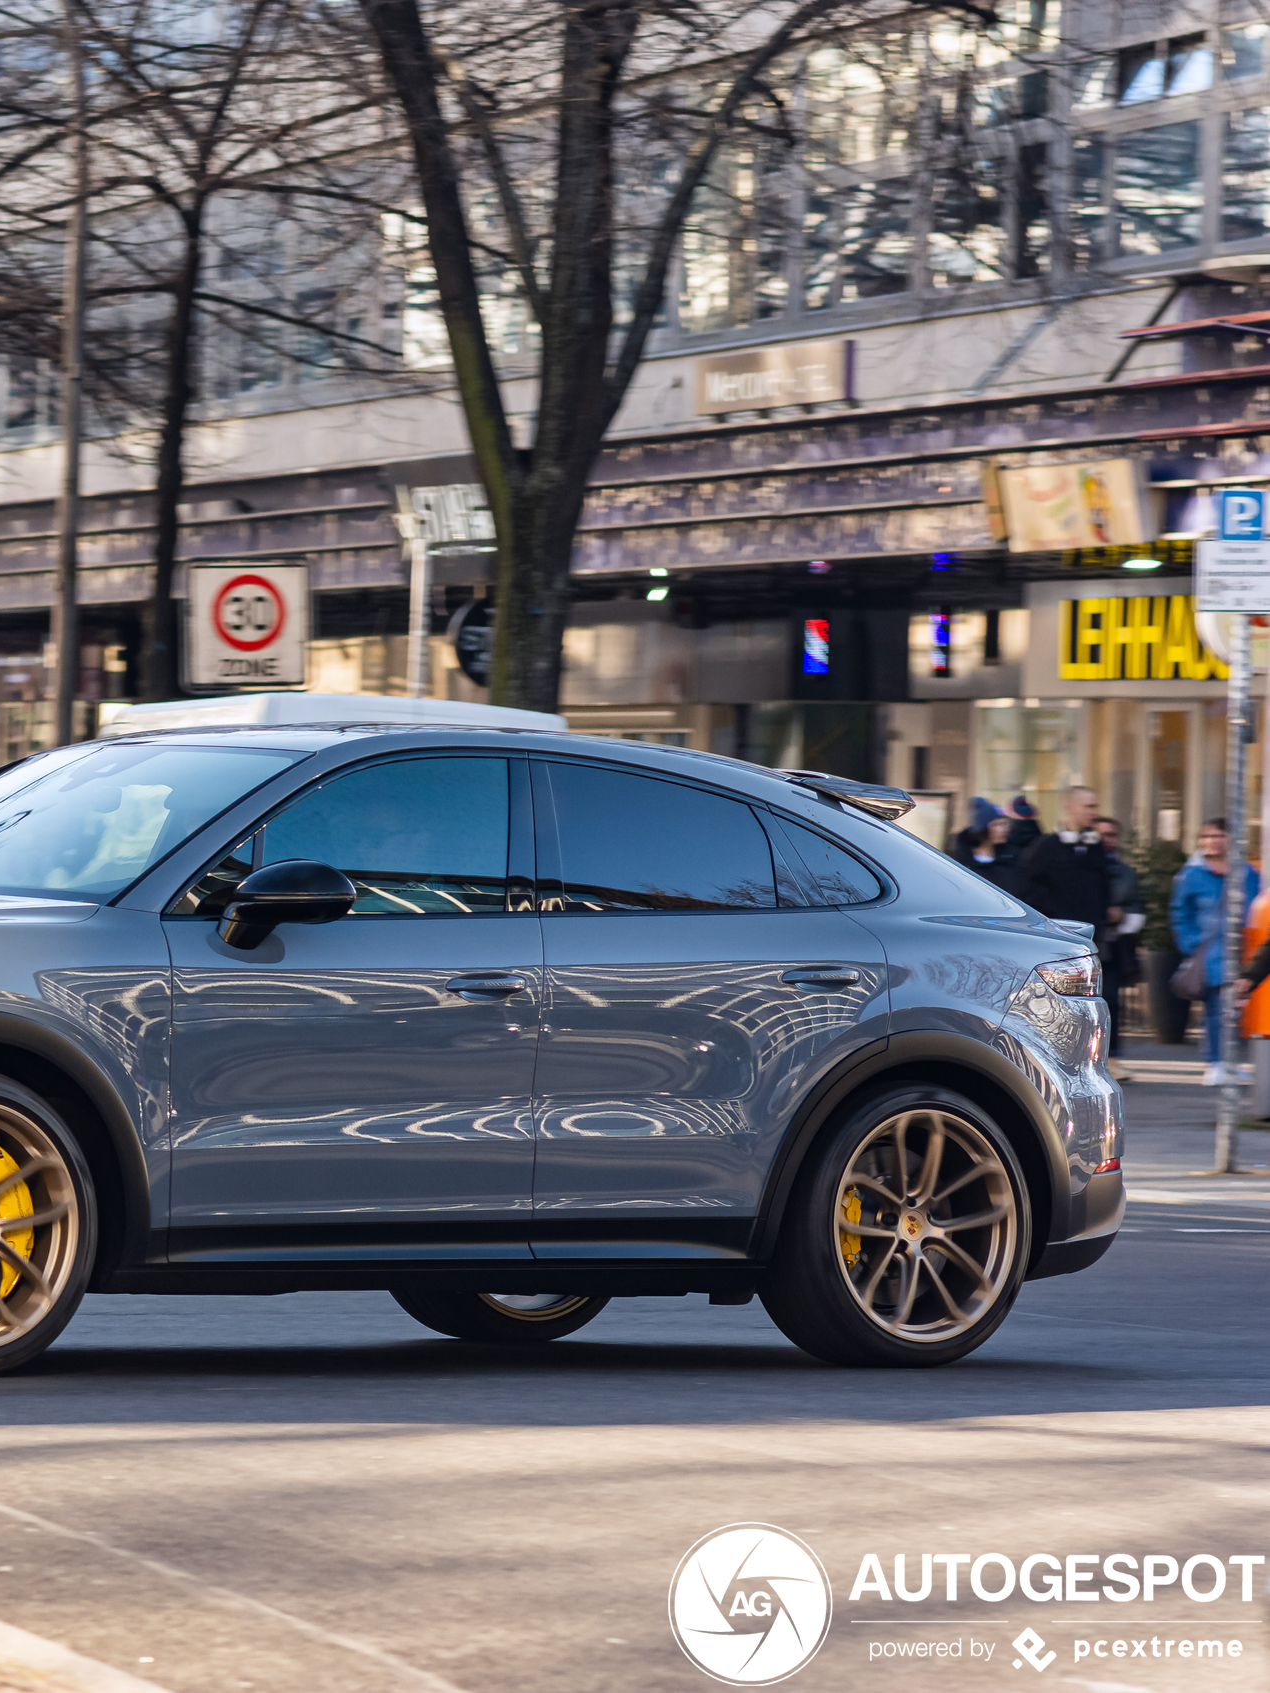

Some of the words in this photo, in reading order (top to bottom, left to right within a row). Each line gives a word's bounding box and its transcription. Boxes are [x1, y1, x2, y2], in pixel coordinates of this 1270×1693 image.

[1224, 496, 1260, 535] P
[225, 597, 273, 630] 30
[219, 657, 280, 676] ZONE
